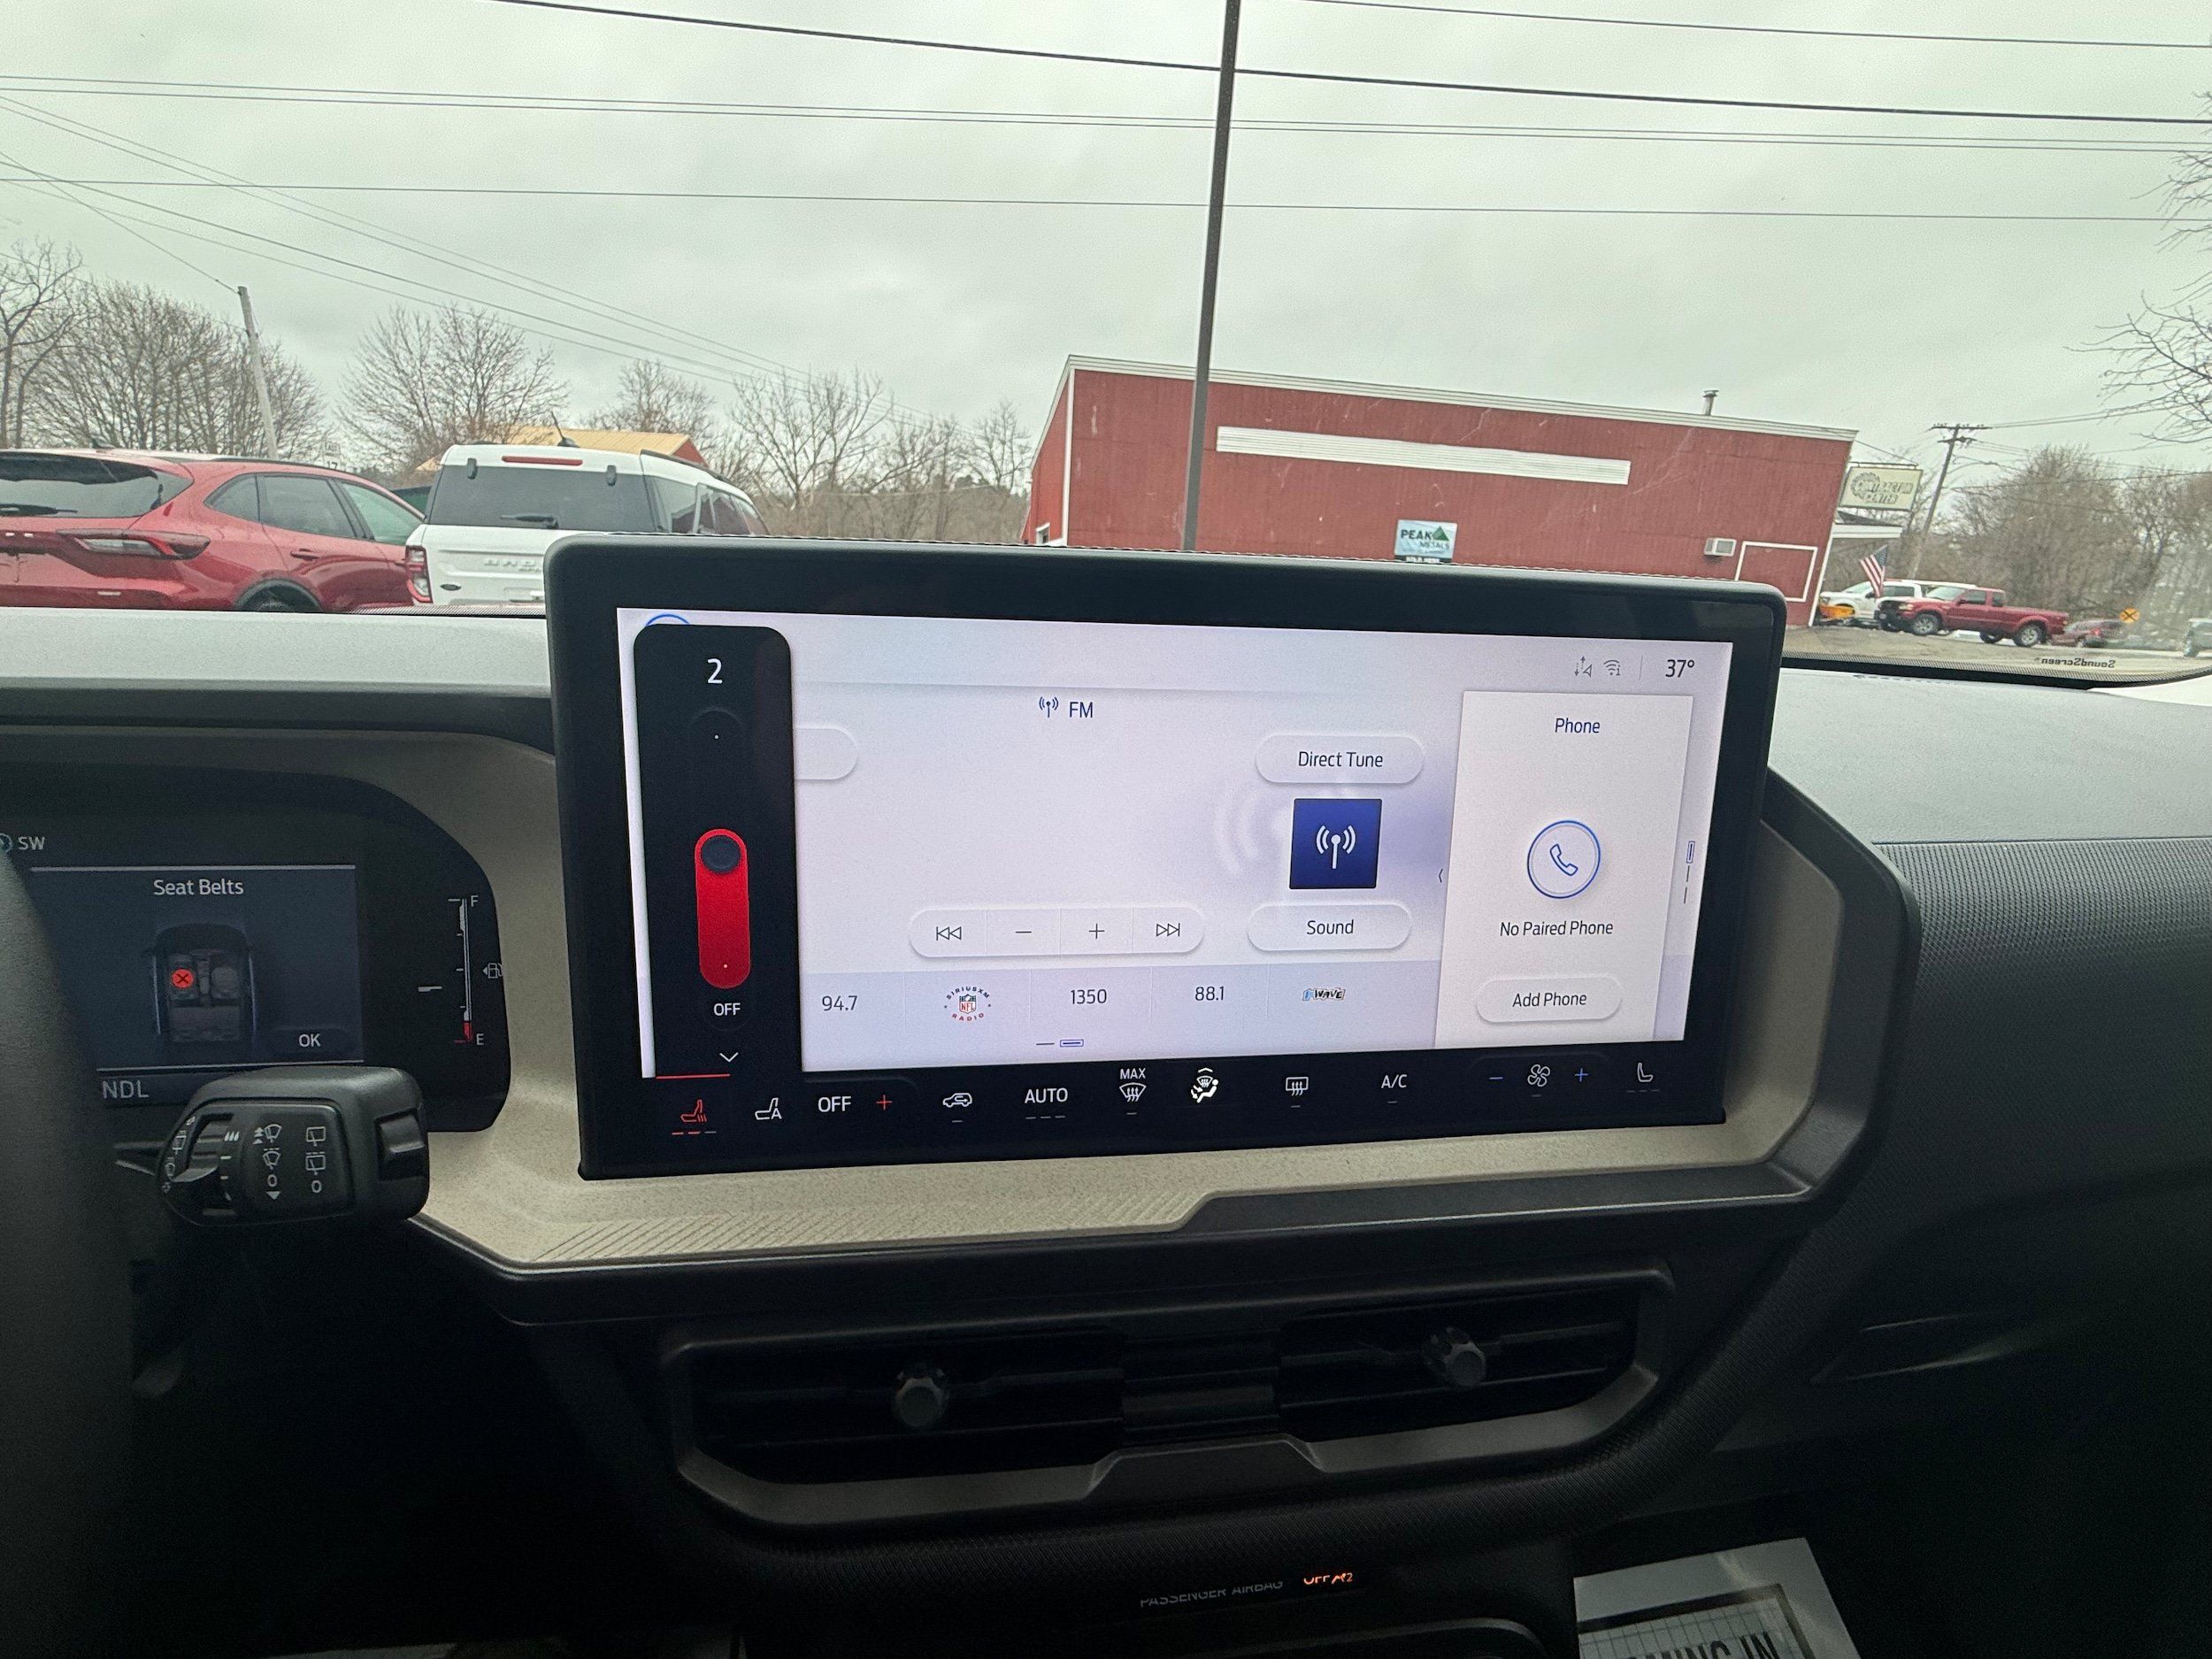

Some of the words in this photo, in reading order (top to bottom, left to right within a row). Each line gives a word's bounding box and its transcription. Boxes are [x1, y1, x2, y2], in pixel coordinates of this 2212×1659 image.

[1401, 529, 1432, 541] PEAK
[707, 657, 723, 684] 2
[1664, 658, 1695, 678] 37°
[1069, 701, 1094, 718] FM
[1555, 717, 1601, 733] Phone
[1298, 750, 1342, 767] Direct
[1346, 751, 1383, 768] Tune
[18, 835, 45, 850] SW
[153, 879, 195, 895] Seat
[198, 878, 244, 895] Belts
[470, 895, 479, 908] F
[1306, 918, 1355, 935] Sound
[1500, 921, 1519, 936] No
[1523, 920, 1567, 936] Paired
[1570, 919, 1614, 935] Phone
[946, 986, 990, 1000] SIRIUSXM
[1071, 988, 1107, 1005] 1350
[1194, 986, 1225, 1002] 88.1
[1512, 992, 1540, 1008] Add
[1543, 992, 1587, 1007] Phone
[713, 1002, 741, 1017] OFF
[822, 995, 858, 1011] 94.7
[961, 1002, 975, 1012] NFL
[951, 1012, 985, 1022] RADIO
[298, 1033, 321, 1048] OK
[476, 1033, 484, 1046] E
[1119, 1067, 1147, 1079] MAX
[1380, 1073, 1408, 1089] A/C
[102, 1079, 150, 1099] NDL
[1024, 1087, 1069, 1104] AUTO
[818, 1095, 852, 1113] OFF
